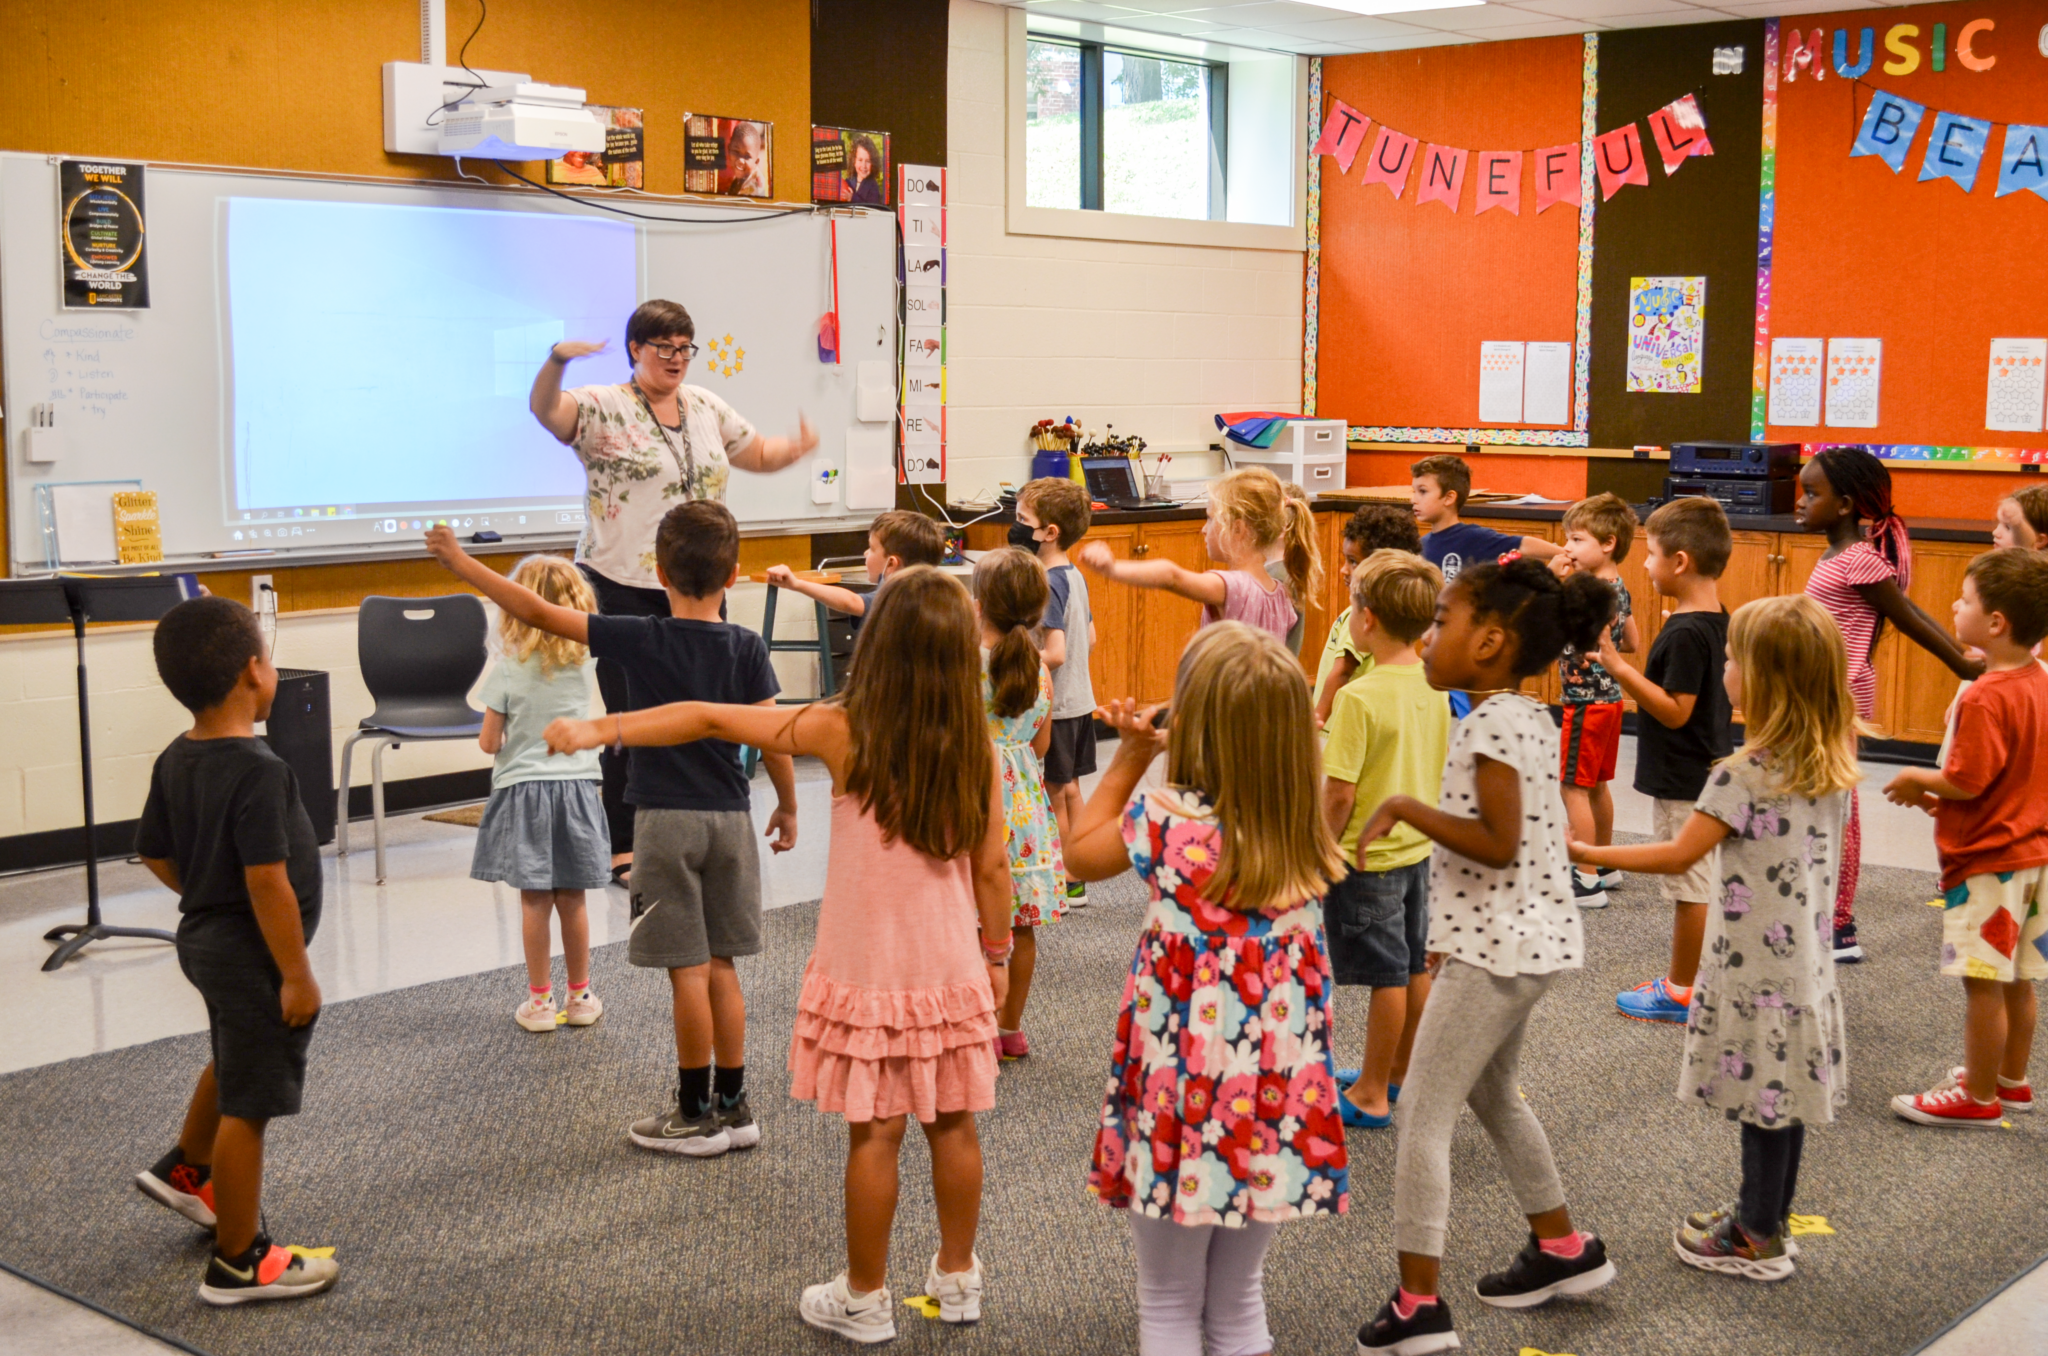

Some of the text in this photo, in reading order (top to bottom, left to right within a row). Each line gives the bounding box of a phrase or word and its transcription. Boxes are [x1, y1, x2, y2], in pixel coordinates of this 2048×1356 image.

[1783, 18, 1996, 82] MUSIC
[1340, 110, 1693, 195] TUNEFUL
[79, 164, 126, 175] TOGETHER
[84, 174, 122, 184] WE WILL
[907, 178, 924, 193] DO
[912, 220, 922, 232] TI
[908, 260, 922, 272] LA
[80, 271, 113, 280] CHANGE
[89, 281, 122, 290] WORLD
[907, 299, 926, 311] SOL
[40, 318, 134, 344] Compassionate
[909, 339, 924, 352] FA
[76, 349, 100, 362] Kind
[78, 370, 114, 380] Listen
[909, 379, 922, 392] MI
[80, 387, 128, 404] Participate
[91, 404, 106, 419] try
[906, 418, 922, 431] RE
[907, 459, 924, 472] DO
[118, 497, 152, 507] Glitter
[118, 509, 156, 524] Sparkle
[124, 525, 153, 536] Shine
[123, 553, 162, 563] Be Kind
